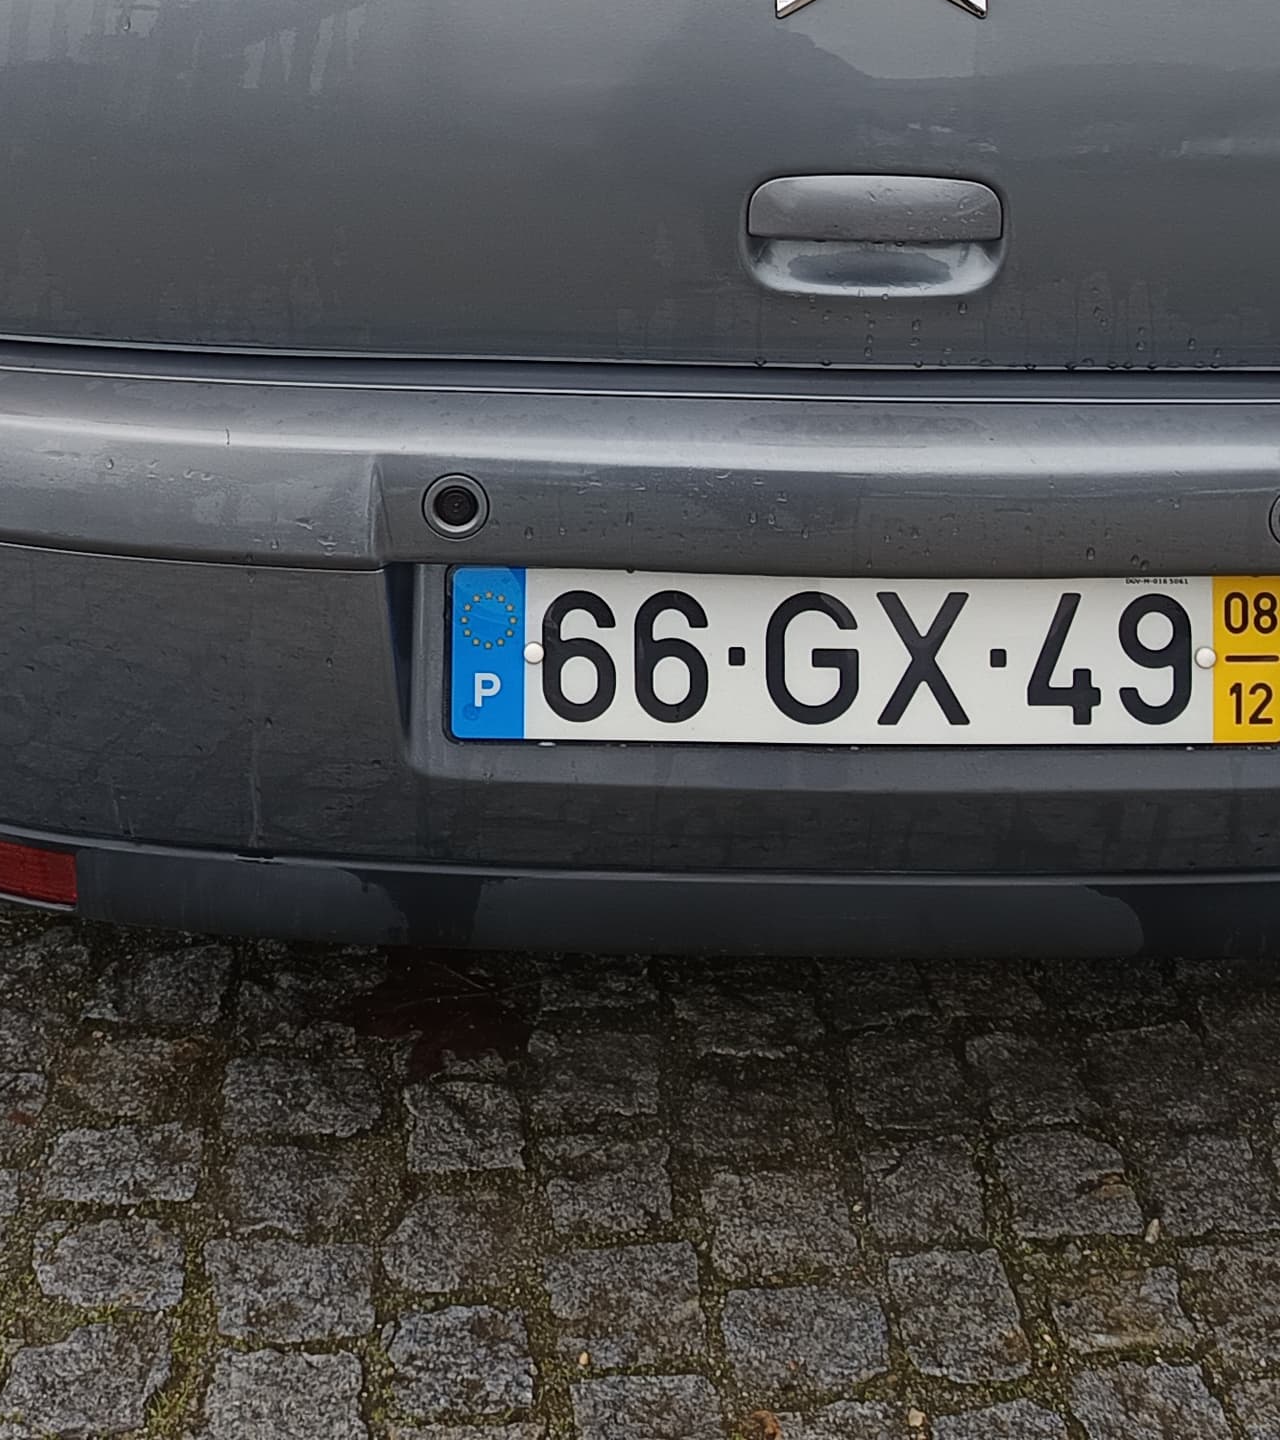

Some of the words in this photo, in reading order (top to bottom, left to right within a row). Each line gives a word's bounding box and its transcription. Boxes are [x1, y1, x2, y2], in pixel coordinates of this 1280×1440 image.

[1224, 591, 1277, 634] 08
[474, 672, 501, 708] P
[1229, 682, 1273, 725] 12
